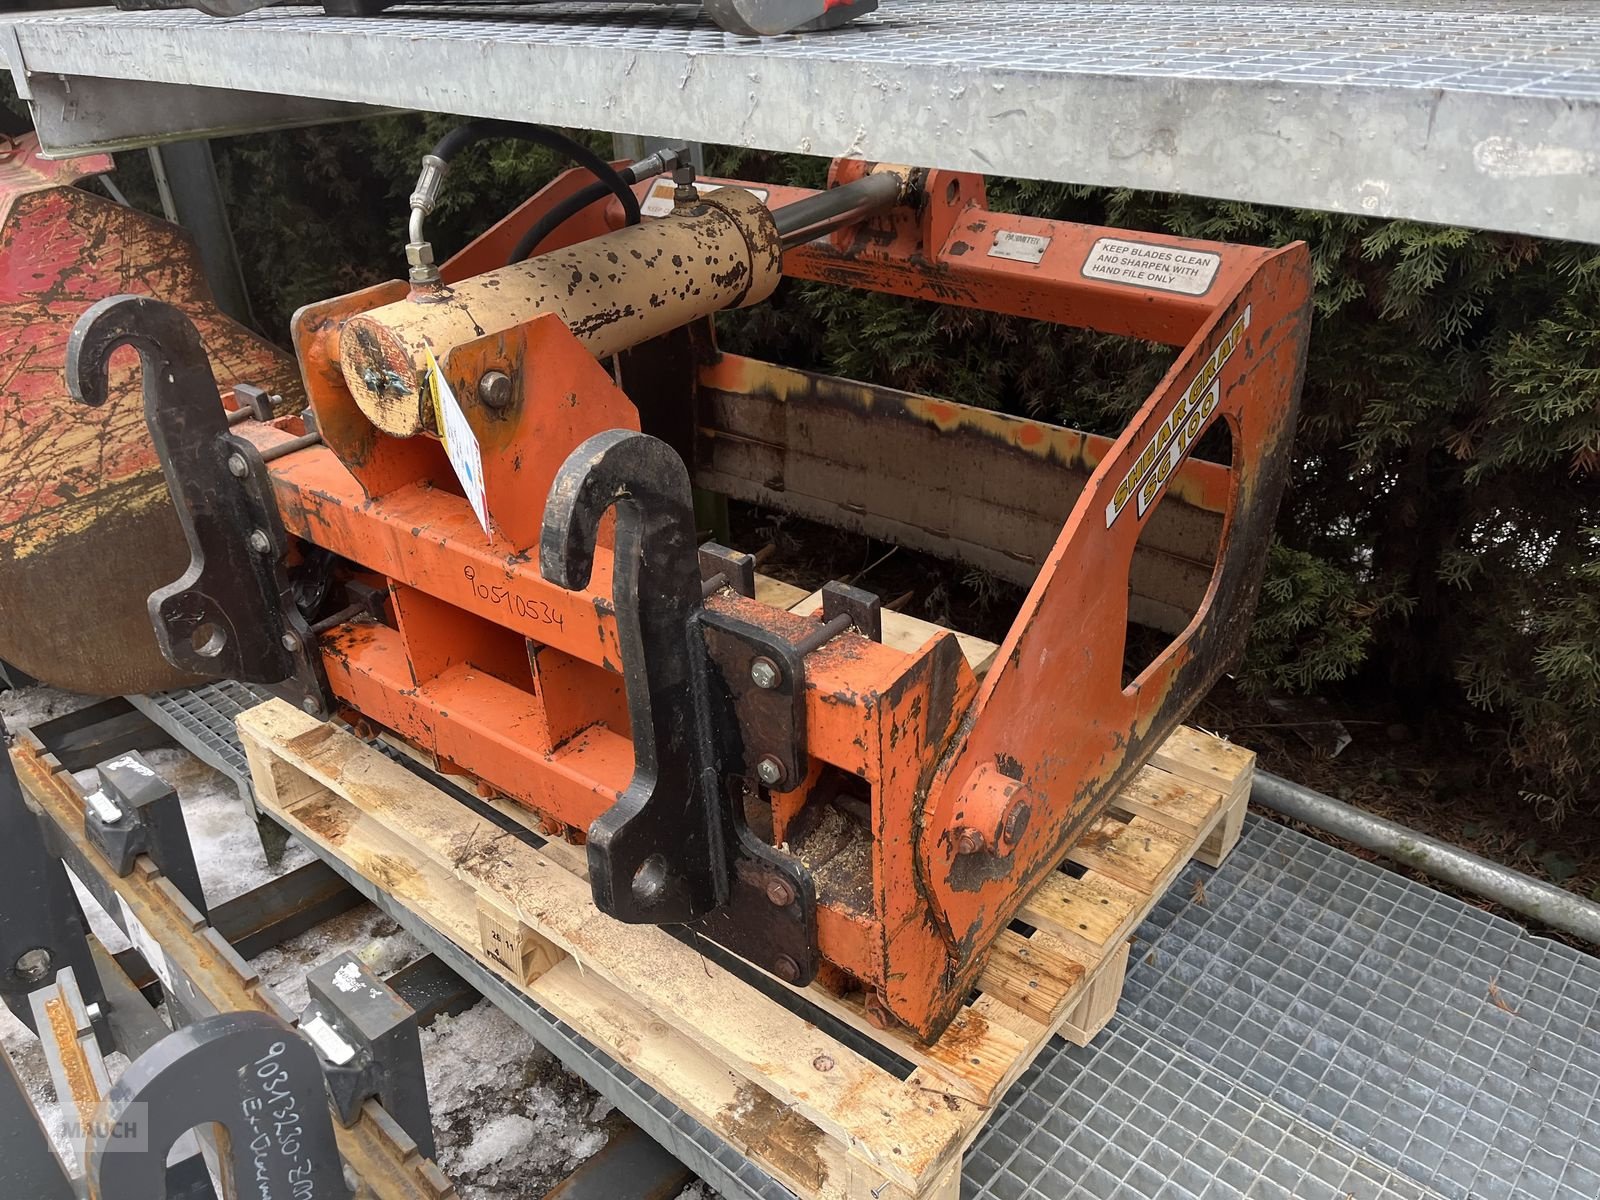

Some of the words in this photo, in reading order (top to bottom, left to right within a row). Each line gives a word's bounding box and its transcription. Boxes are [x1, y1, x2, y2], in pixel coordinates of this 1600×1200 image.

[1092, 264, 1120, 275] HAND
[1122, 268, 1145, 279] FILE
[1147, 273, 1175, 284] ONLY
[1096, 254, 1119, 264] AND
[1120, 257, 1170, 272] SHARPEN
[1172, 265, 1199, 277] WITH
[1102, 243, 1129, 254] KEEP
[1130, 248, 1172, 261] BLADES
[1174, 254, 1211, 267] CLEAN
[1113, 399, 1187, 513] SHEAR
[1143, 451, 1171, 505] SG
[1178, 391, 1214, 454] 100
[464, 565, 563, 632] 90510534
